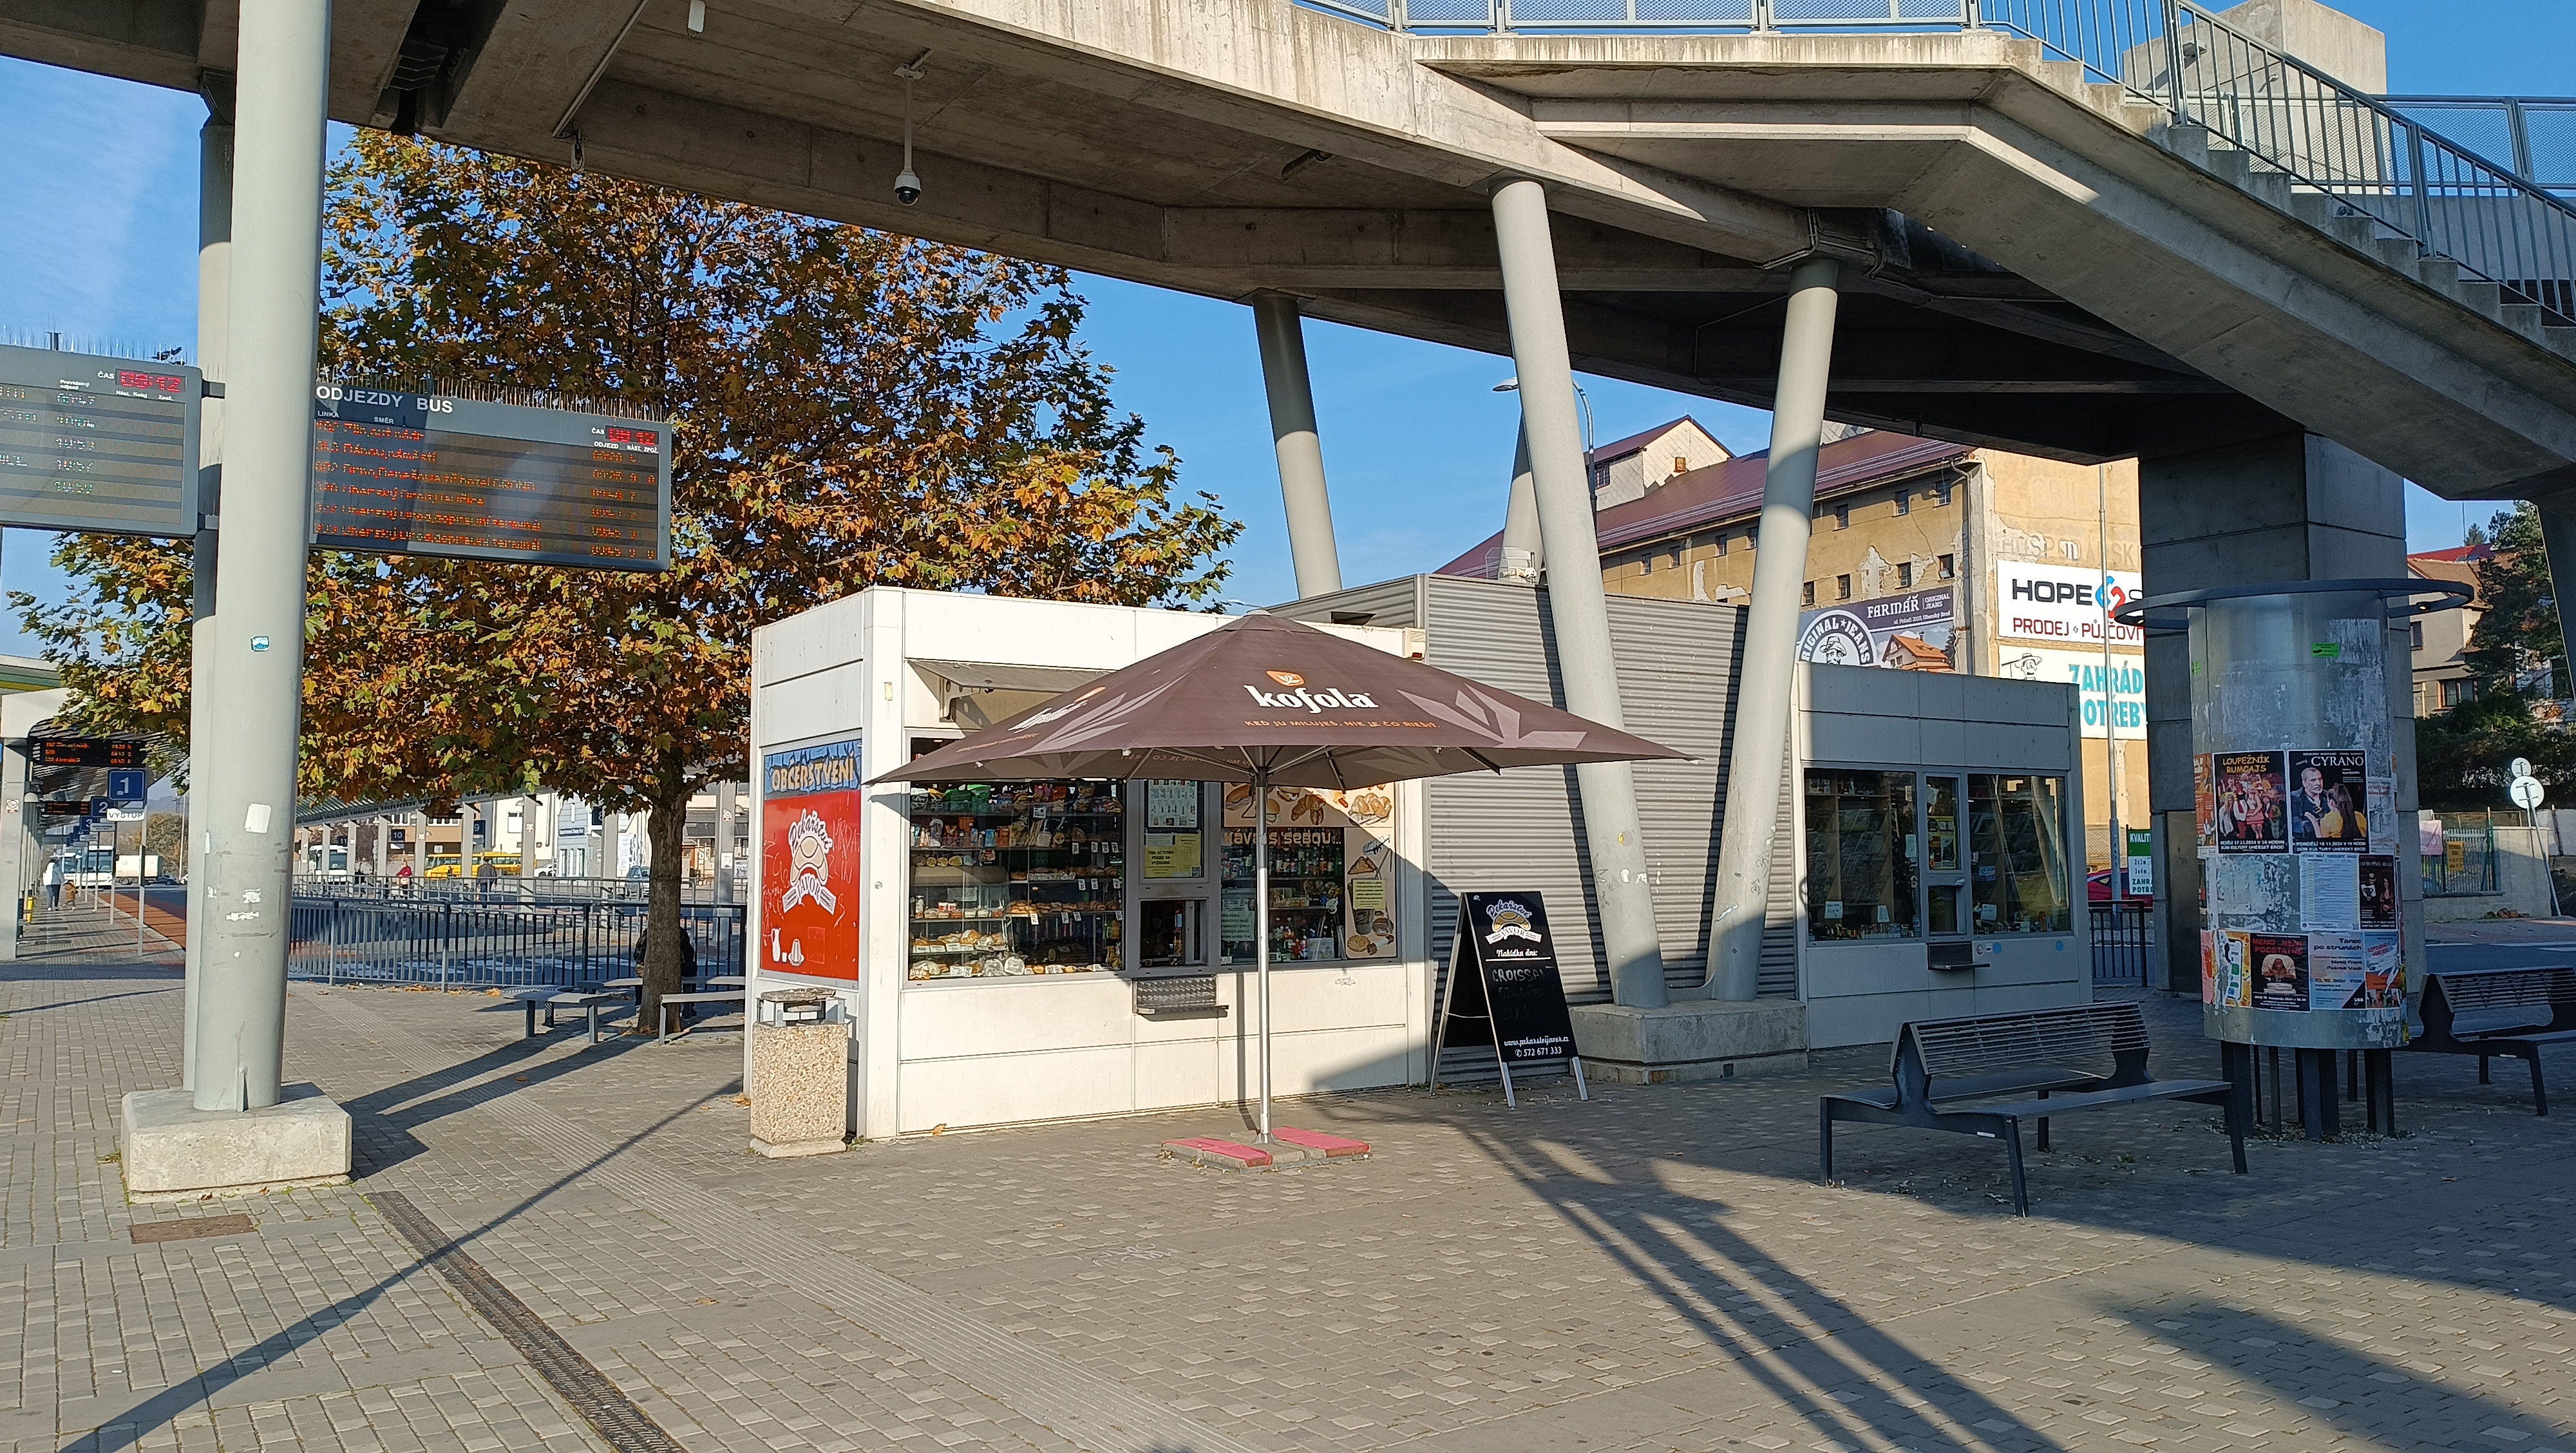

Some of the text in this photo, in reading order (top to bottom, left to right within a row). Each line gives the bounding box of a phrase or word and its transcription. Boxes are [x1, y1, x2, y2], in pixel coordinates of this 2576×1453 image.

[98, 371, 115, 379] ČAS
[316, 386, 453, 413] ODJEZDY BUS
[317, 410, 339, 419] LINKA
[374, 416, 394, 424] SMĚR
[2012, 578, 2092, 605] HOPE
[1924, 593, 1950, 603] ORIGINAL
[1867, 594, 1920, 618] FARMÁŘ
[1924, 602, 1943, 610] JEANS
[2013, 618, 2069, 636] PRODEJ
[1801, 617, 1870, 663] RIGINAL JEANS
[1243, 685, 1379, 714] kofola
[2083, 695, 2146, 728] OTŘEB
[2222, 754, 2270, 766] LOUPEŽNÍK
[2311, 756, 2364, 766] CYRANO
[772, 752, 855, 792] OBČERSTVENÍ
[2226, 764, 2267, 774] RUMCAJS
[120, 777, 129, 793] 1
[99, 801, 108, 813] 2
[86, 819, 93, 828] 3
[474, 823, 480, 831] 9
[1496, 949, 1524, 958] Nabídka
[1523, 1046, 1562, 1057] 572 671 333
